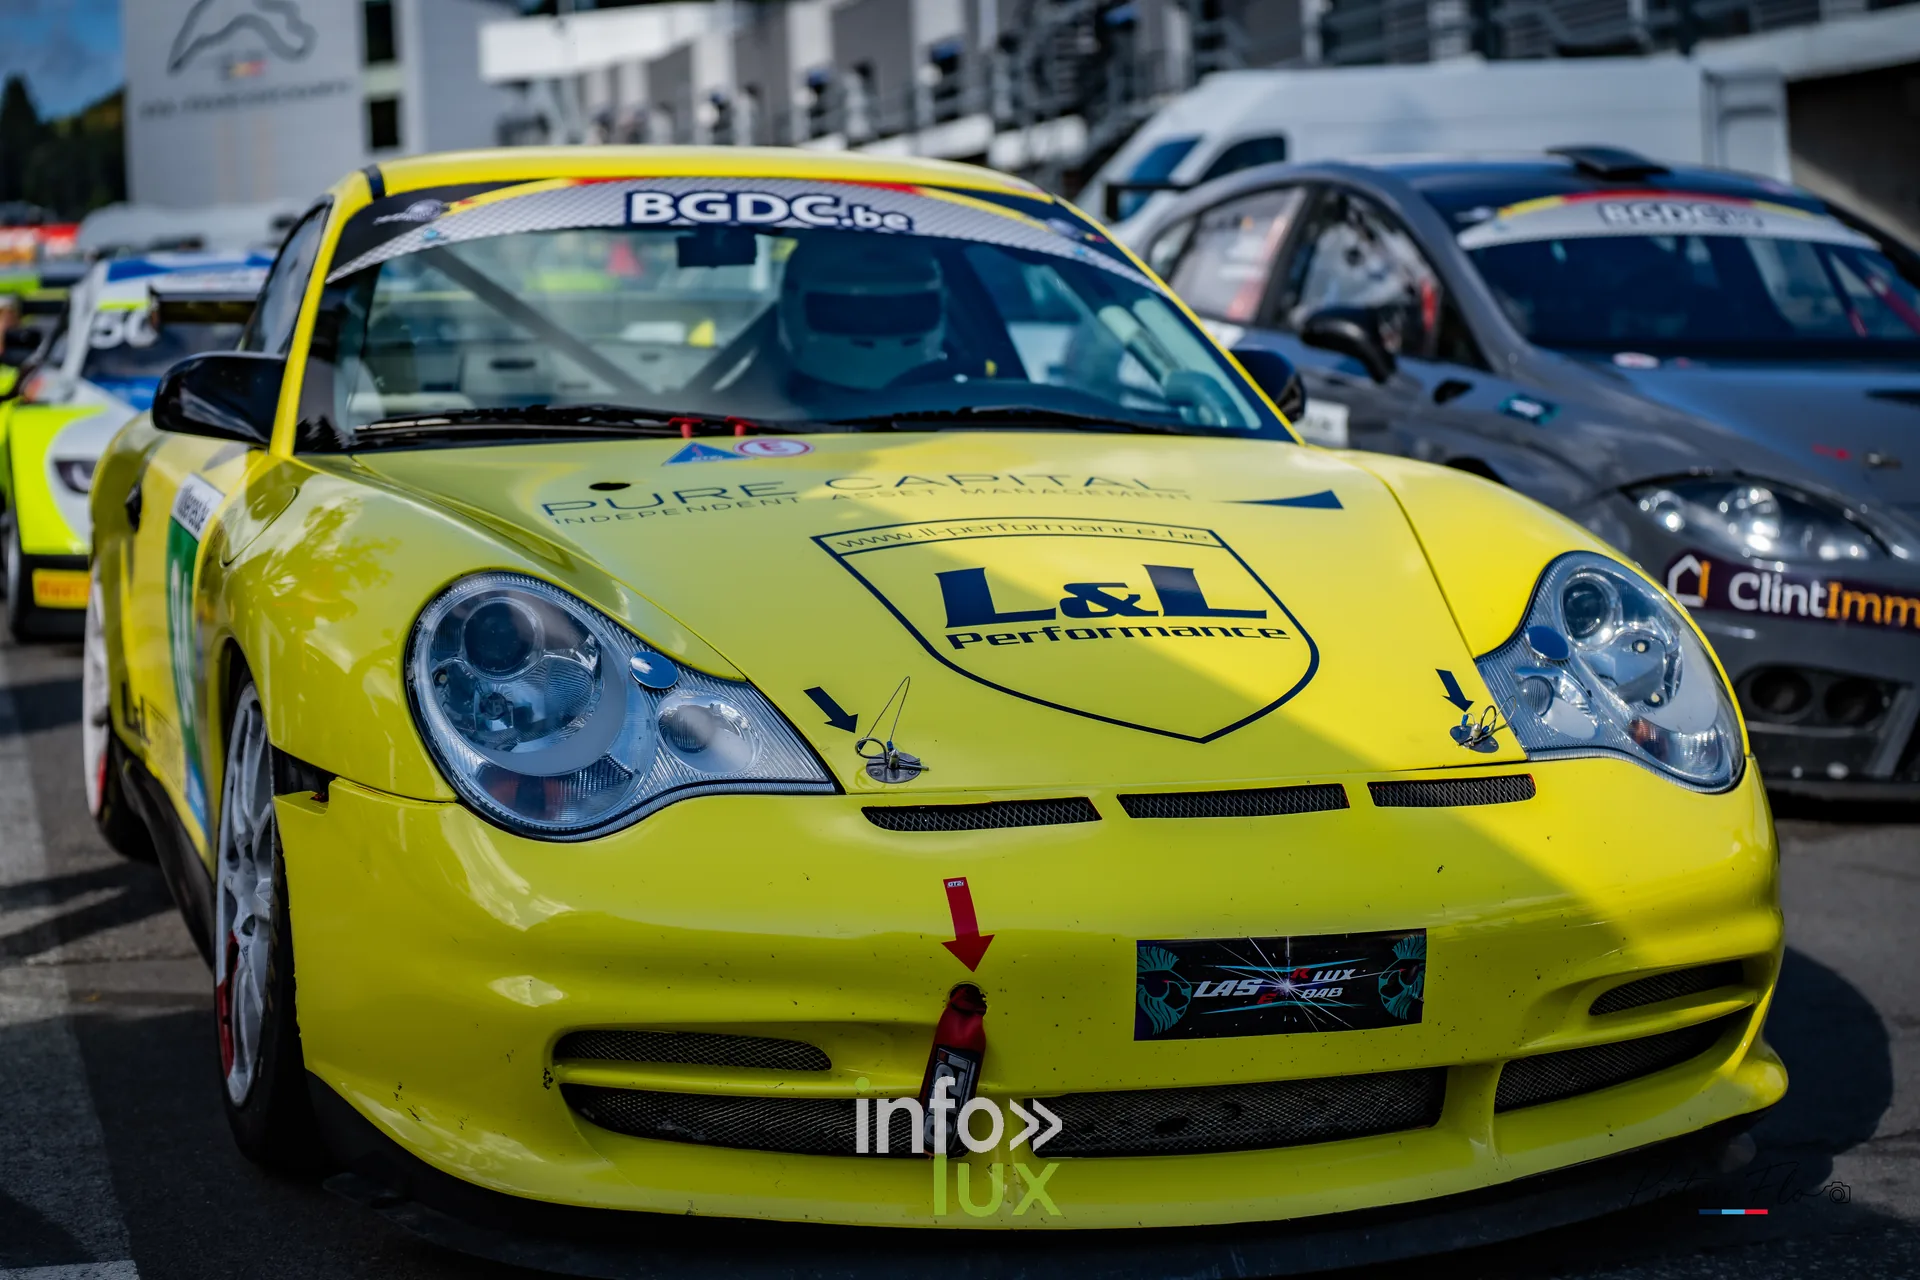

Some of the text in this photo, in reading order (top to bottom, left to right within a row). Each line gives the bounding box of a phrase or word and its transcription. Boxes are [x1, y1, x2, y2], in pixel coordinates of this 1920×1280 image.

[630, 191, 910, 231] BGDC.be
[541, 473, 1187, 517] PURE CAPITAL
[552, 486, 1193, 526] INDEPENDENT ASSET MANAGEMENT
[836, 522, 1208, 549] www.ll-performance.be
[934, 563, 1268, 629] L&L
[945, 624, 1291, 651] Performance
[1312, 968, 1356, 982] LUX
